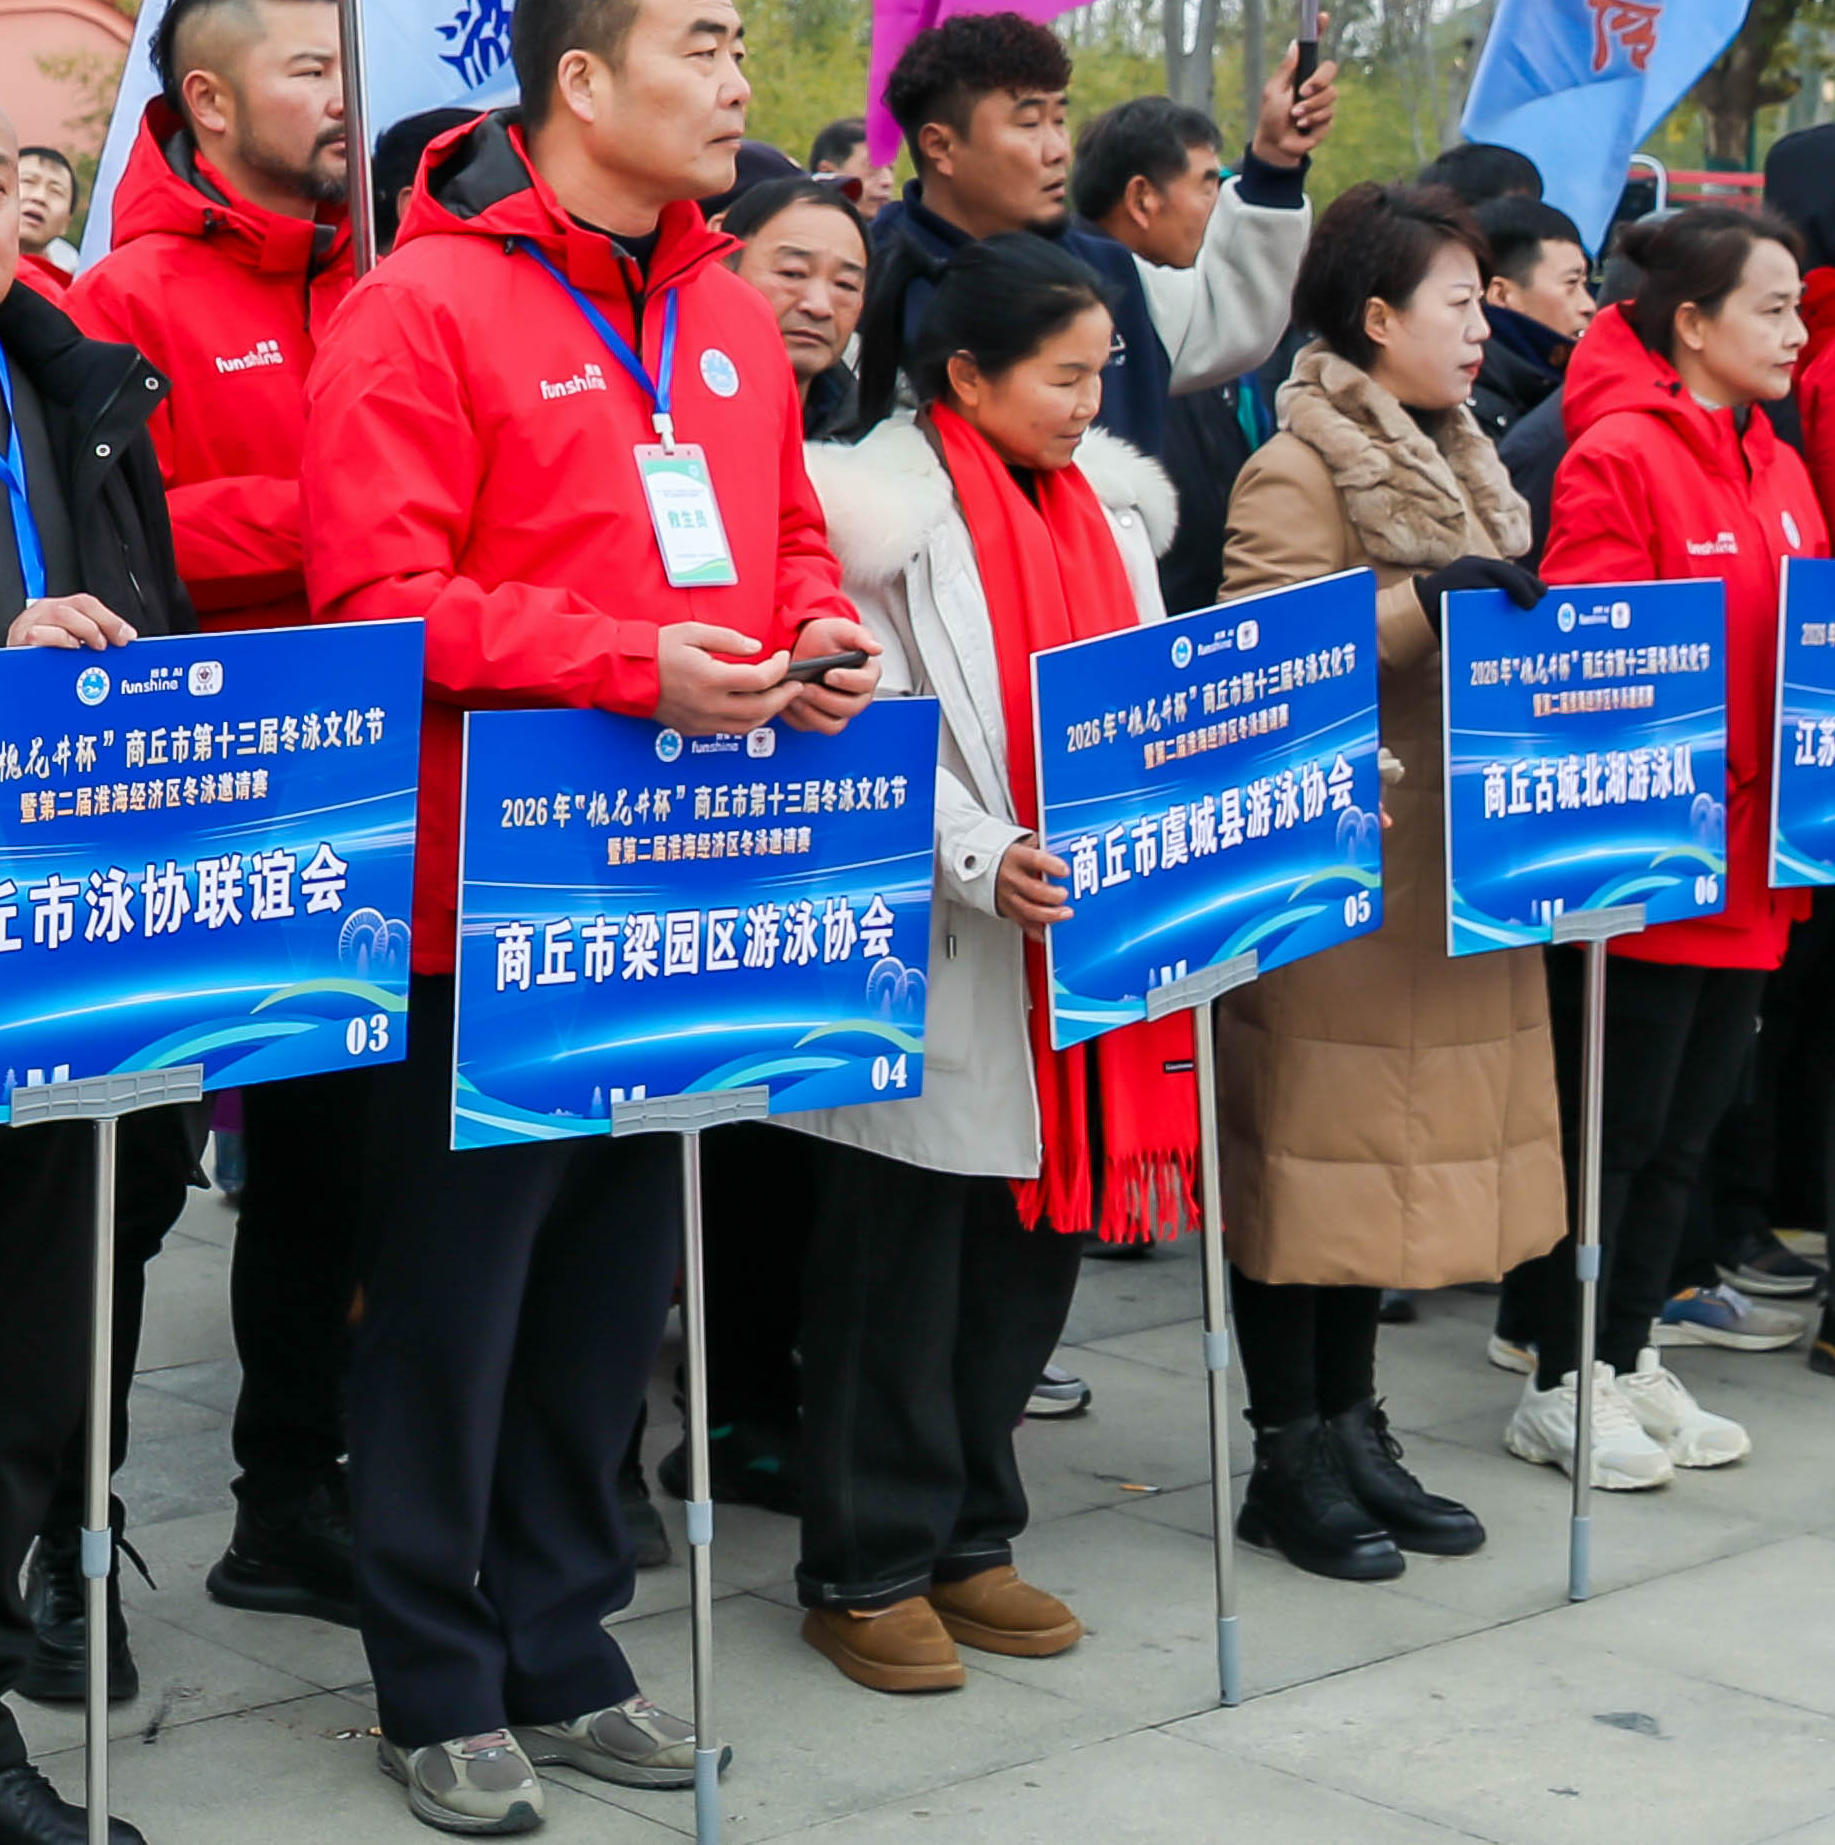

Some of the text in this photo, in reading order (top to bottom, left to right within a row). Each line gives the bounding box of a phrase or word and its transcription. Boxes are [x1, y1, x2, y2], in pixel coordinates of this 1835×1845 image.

[121, 678, 179, 695] funshine
[125, 706, 386, 770] 商丘市第十三届冬泳文化节
[19, 768, 270, 825] 暨第二届淮海经济区冬泳邀请赛
[1482, 742, 1697, 820] 商丘古城北湖游泳队
[1069, 752, 1356, 902] 商丘市虞城县游泳协会
[1343, 890, 1372, 928] 05
[1694, 873, 1719, 906] 06
[495, 894, 896, 993] 商丘市梁园区游泳协会
[346, 1013, 390, 1056] 03
[870, 1054, 908, 1092] 04
